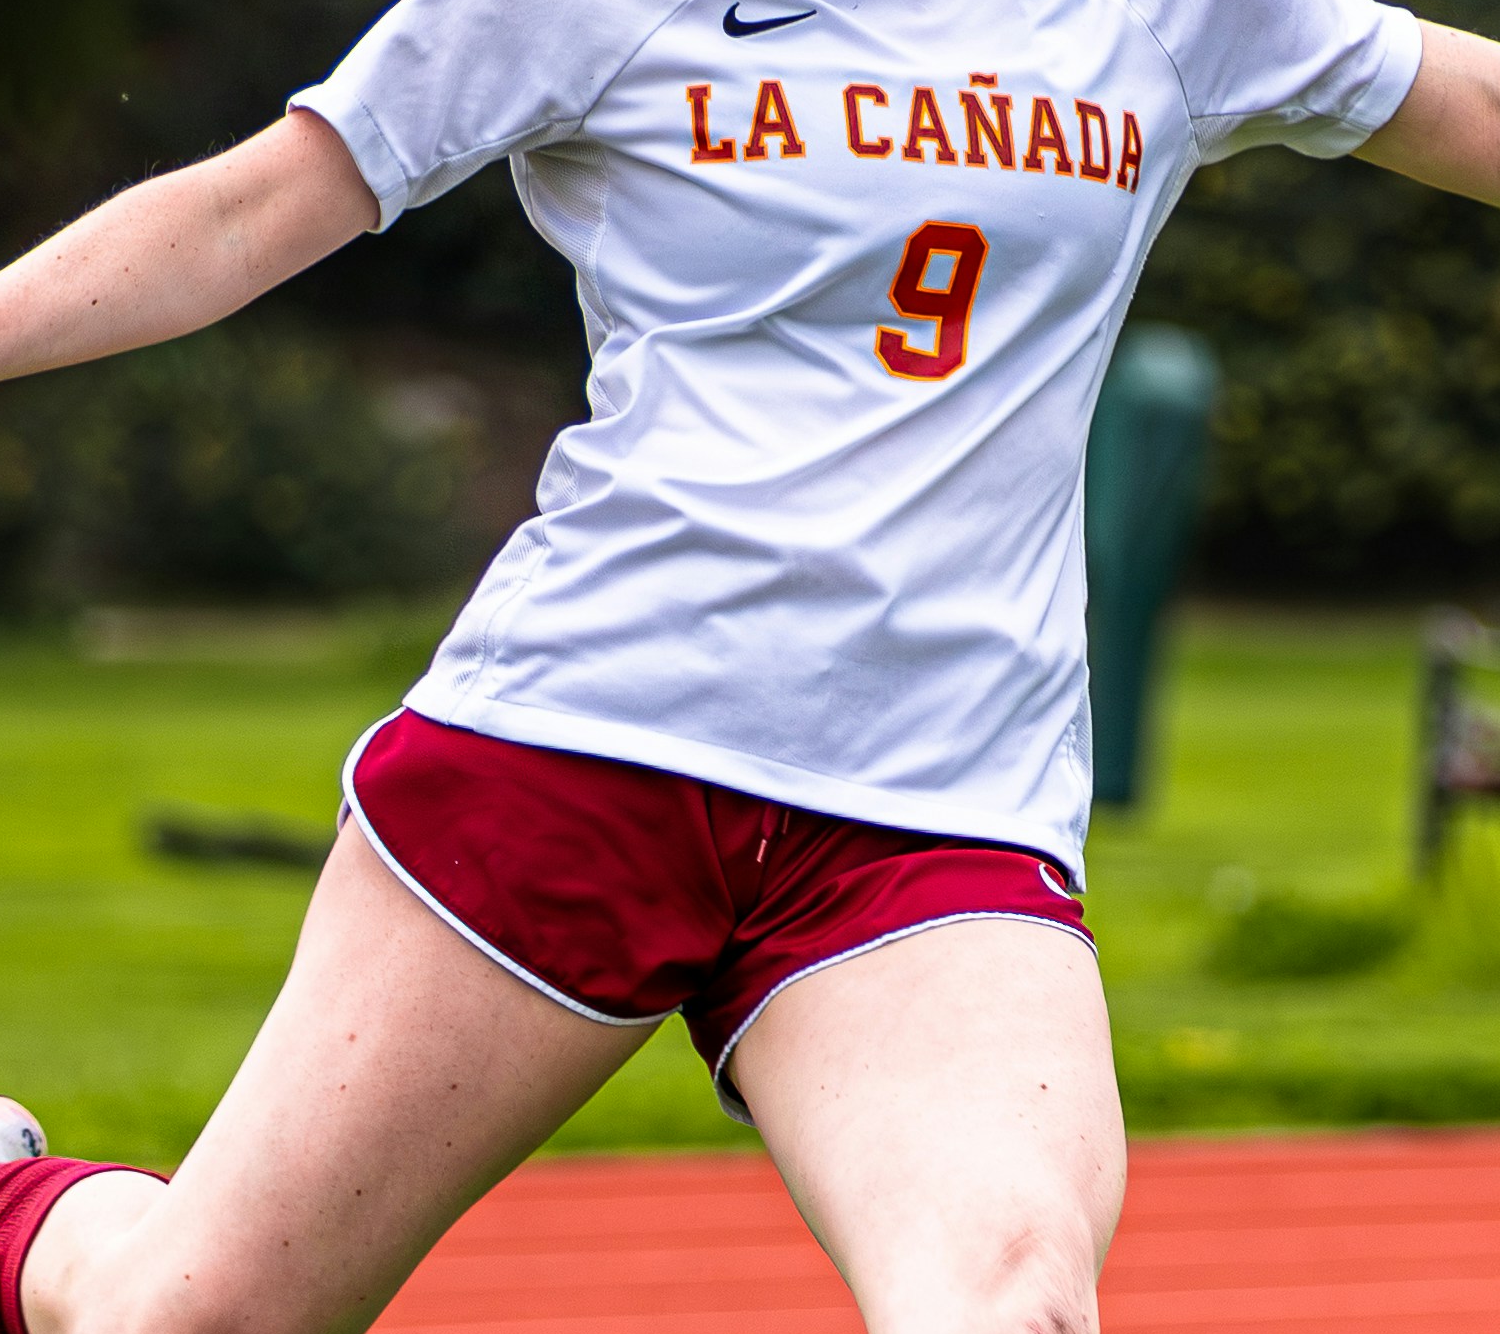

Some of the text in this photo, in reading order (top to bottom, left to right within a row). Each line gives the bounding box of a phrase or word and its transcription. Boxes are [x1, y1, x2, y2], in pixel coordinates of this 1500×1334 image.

[685, 72, 1145, 195] LA CAÑADA
[873, 219, 991, 384] 9
